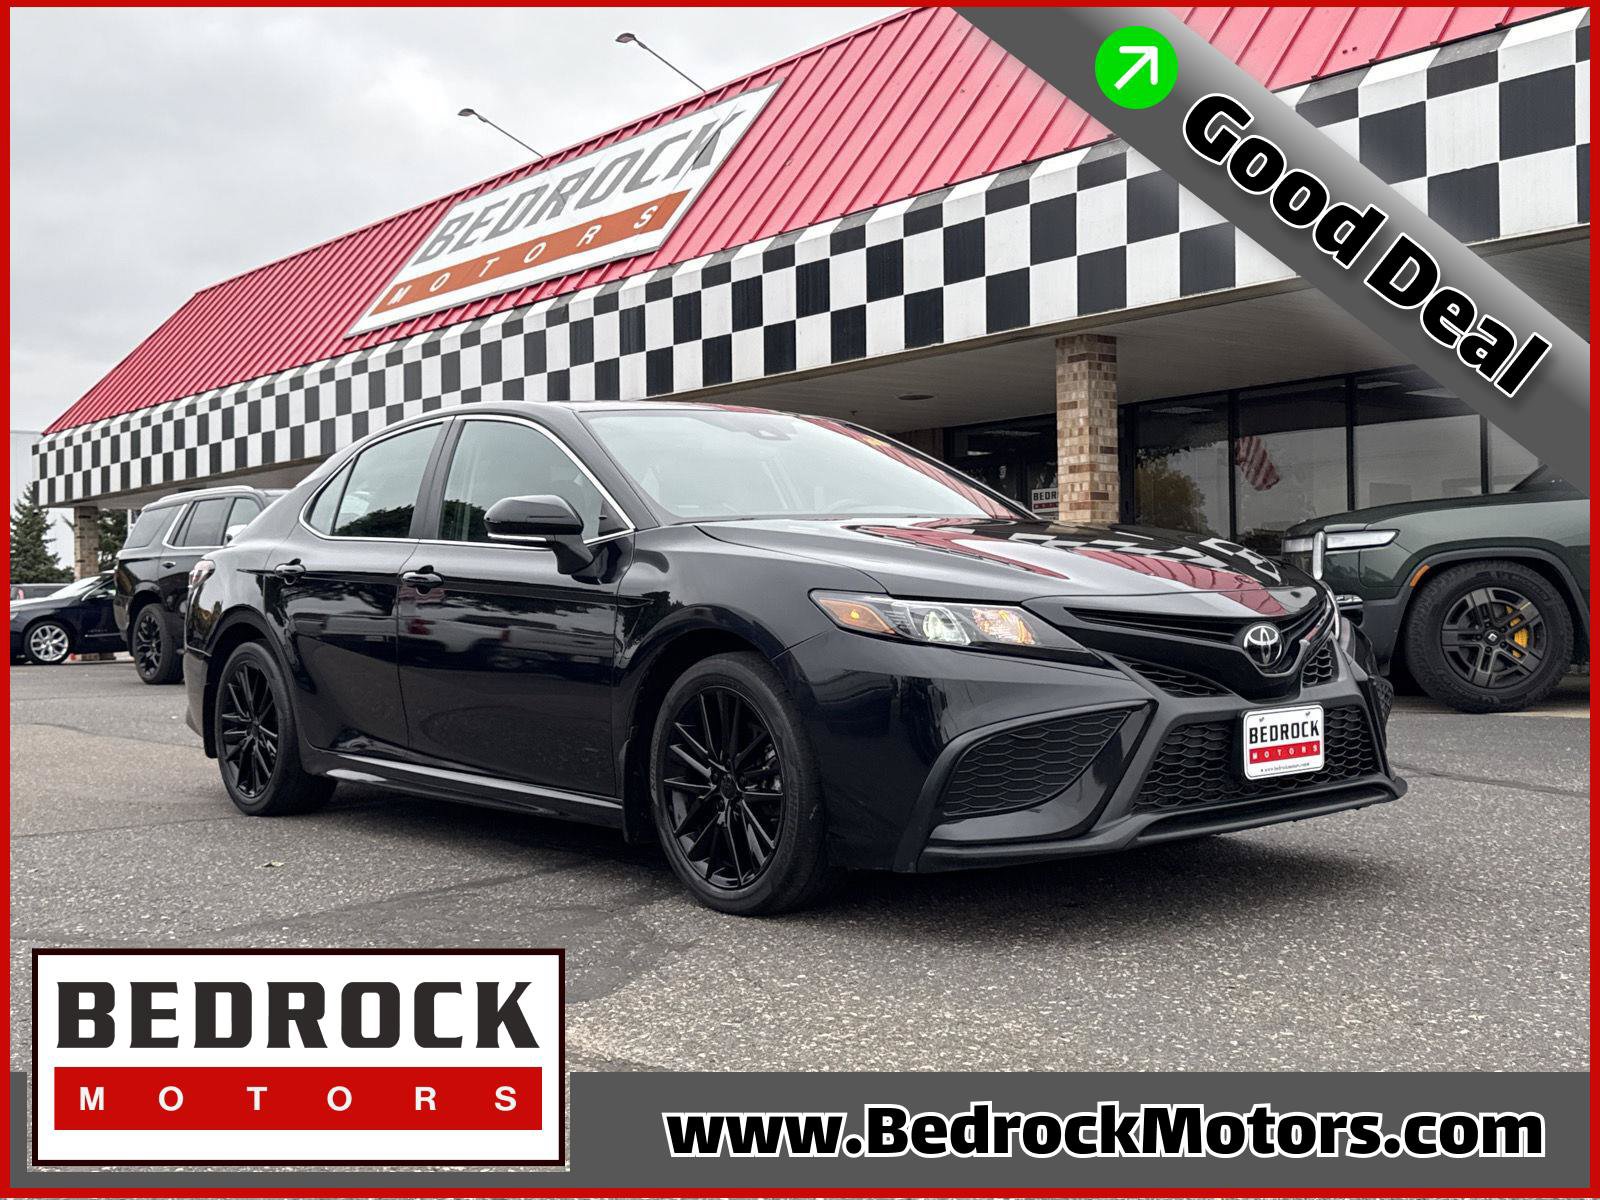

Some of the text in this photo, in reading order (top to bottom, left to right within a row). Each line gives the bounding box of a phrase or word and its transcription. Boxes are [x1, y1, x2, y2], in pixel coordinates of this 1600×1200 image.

[413, 109, 746, 266] BEDROCK
[387, 204, 658, 307] MOTORS
[1249, 719, 1320, 745] BEDROCK
[1252, 744, 1318, 760] MOTORS
